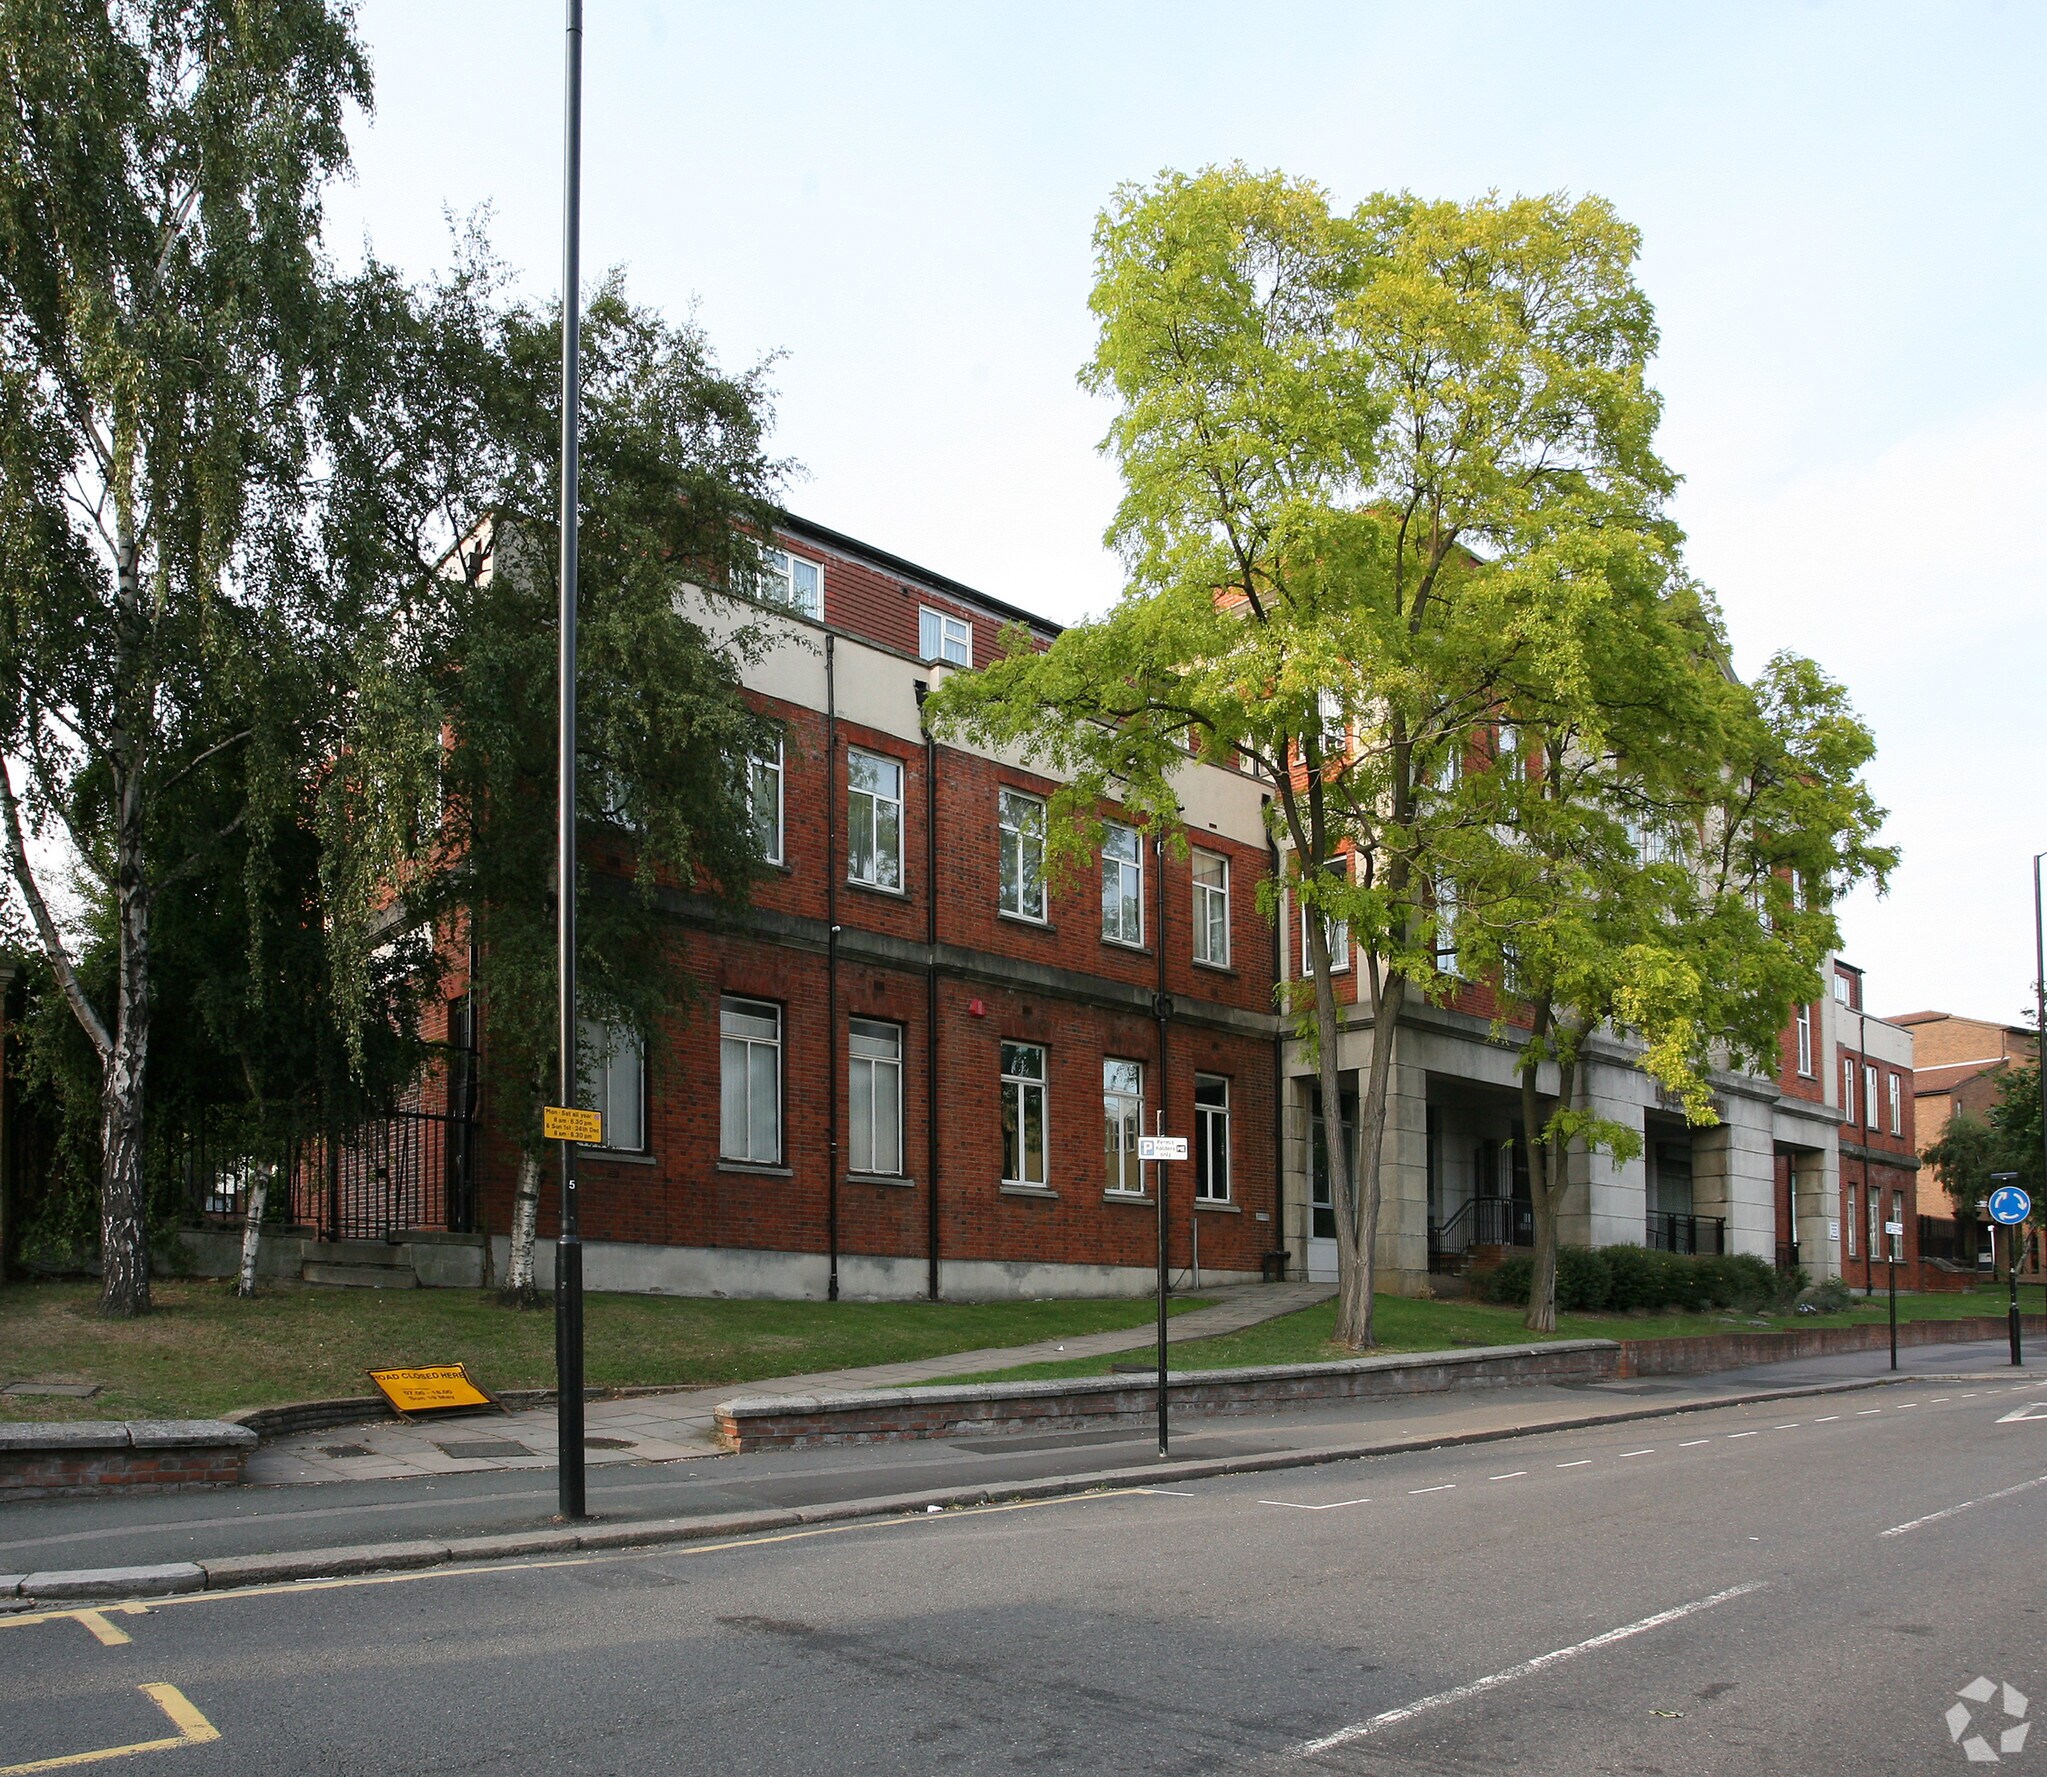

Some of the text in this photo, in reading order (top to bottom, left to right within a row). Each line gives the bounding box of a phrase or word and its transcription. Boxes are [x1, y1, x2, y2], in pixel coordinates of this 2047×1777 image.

[568, 1180, 576, 1190] 5
[401, 1372, 439, 1380] CLOSED
[440, 1371, 465, 1379] HERE
